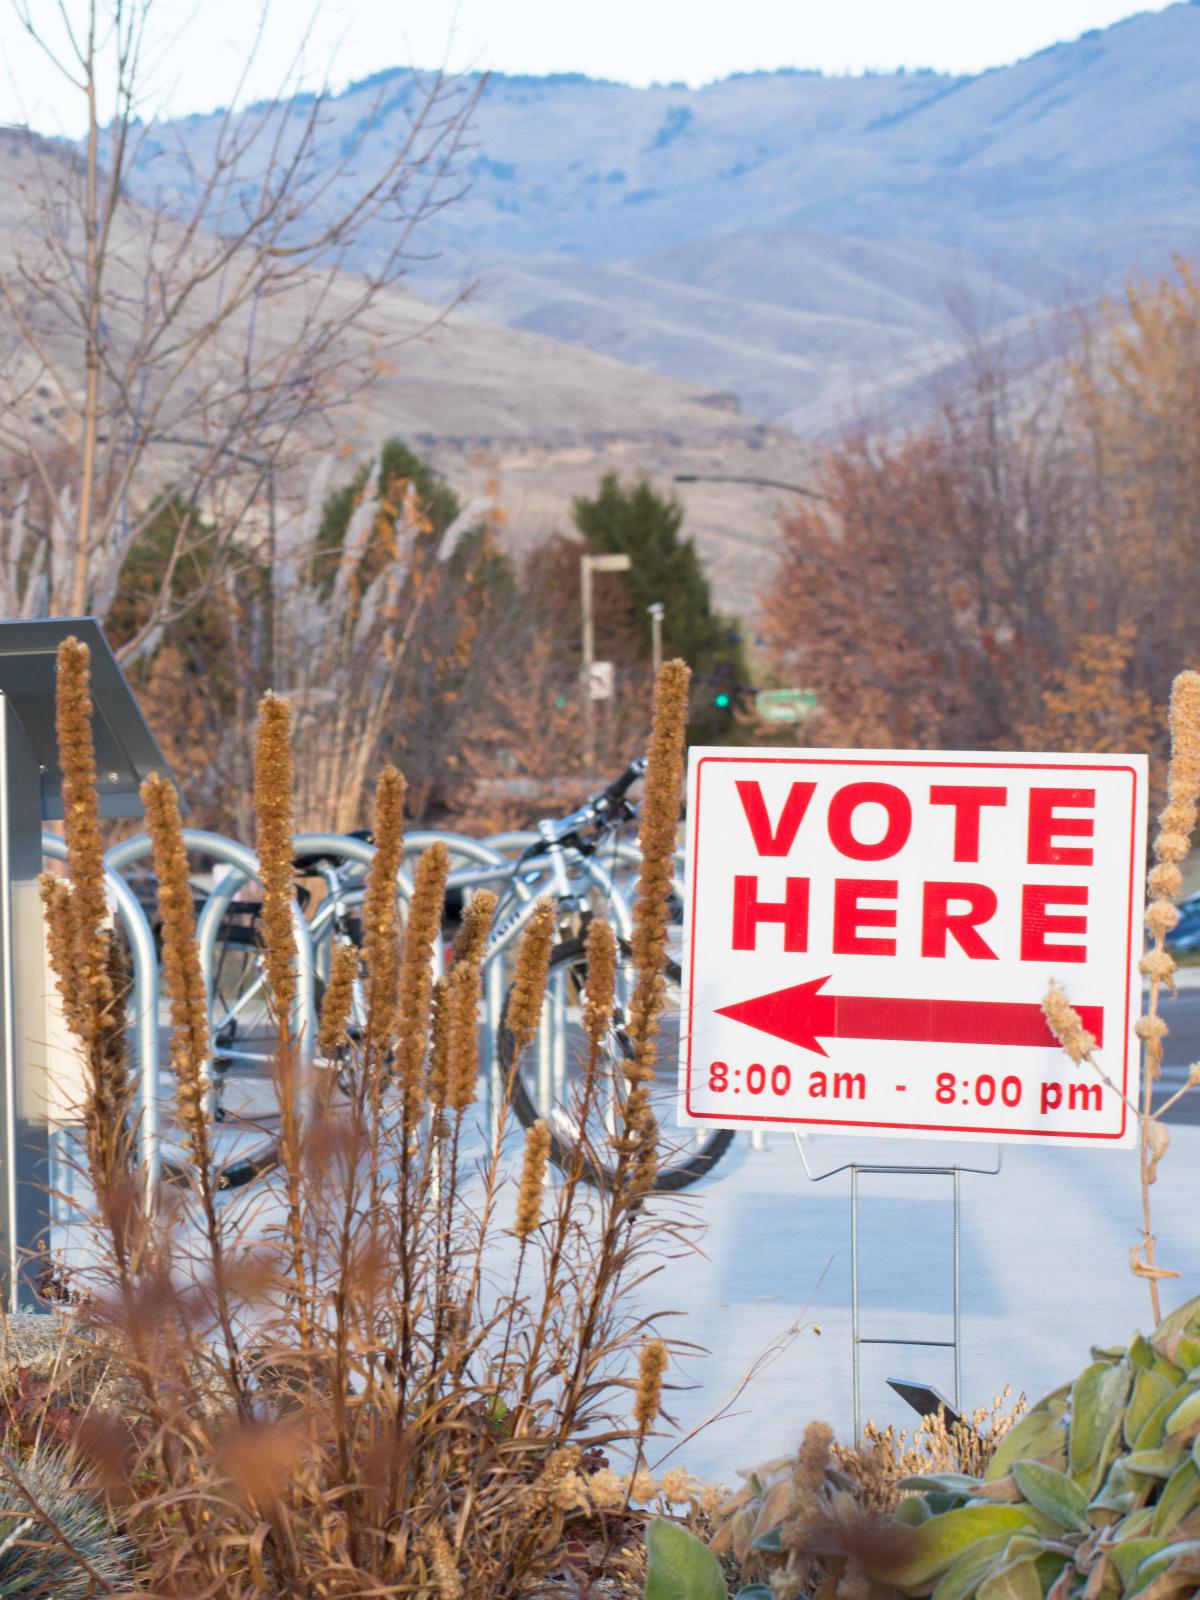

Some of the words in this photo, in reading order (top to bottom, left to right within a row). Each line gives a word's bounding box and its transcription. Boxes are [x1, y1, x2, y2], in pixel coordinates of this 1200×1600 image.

[734, 780, 1097, 867] VOTE
[731, 874, 1090, 964] HERE
[708, 1060, 792, 1097] 8:00
[807, 1070, 867, 1100] am
[934, 1071, 1023, 1108] 8:00
[1039, 1081, 1104, 1115] pm
